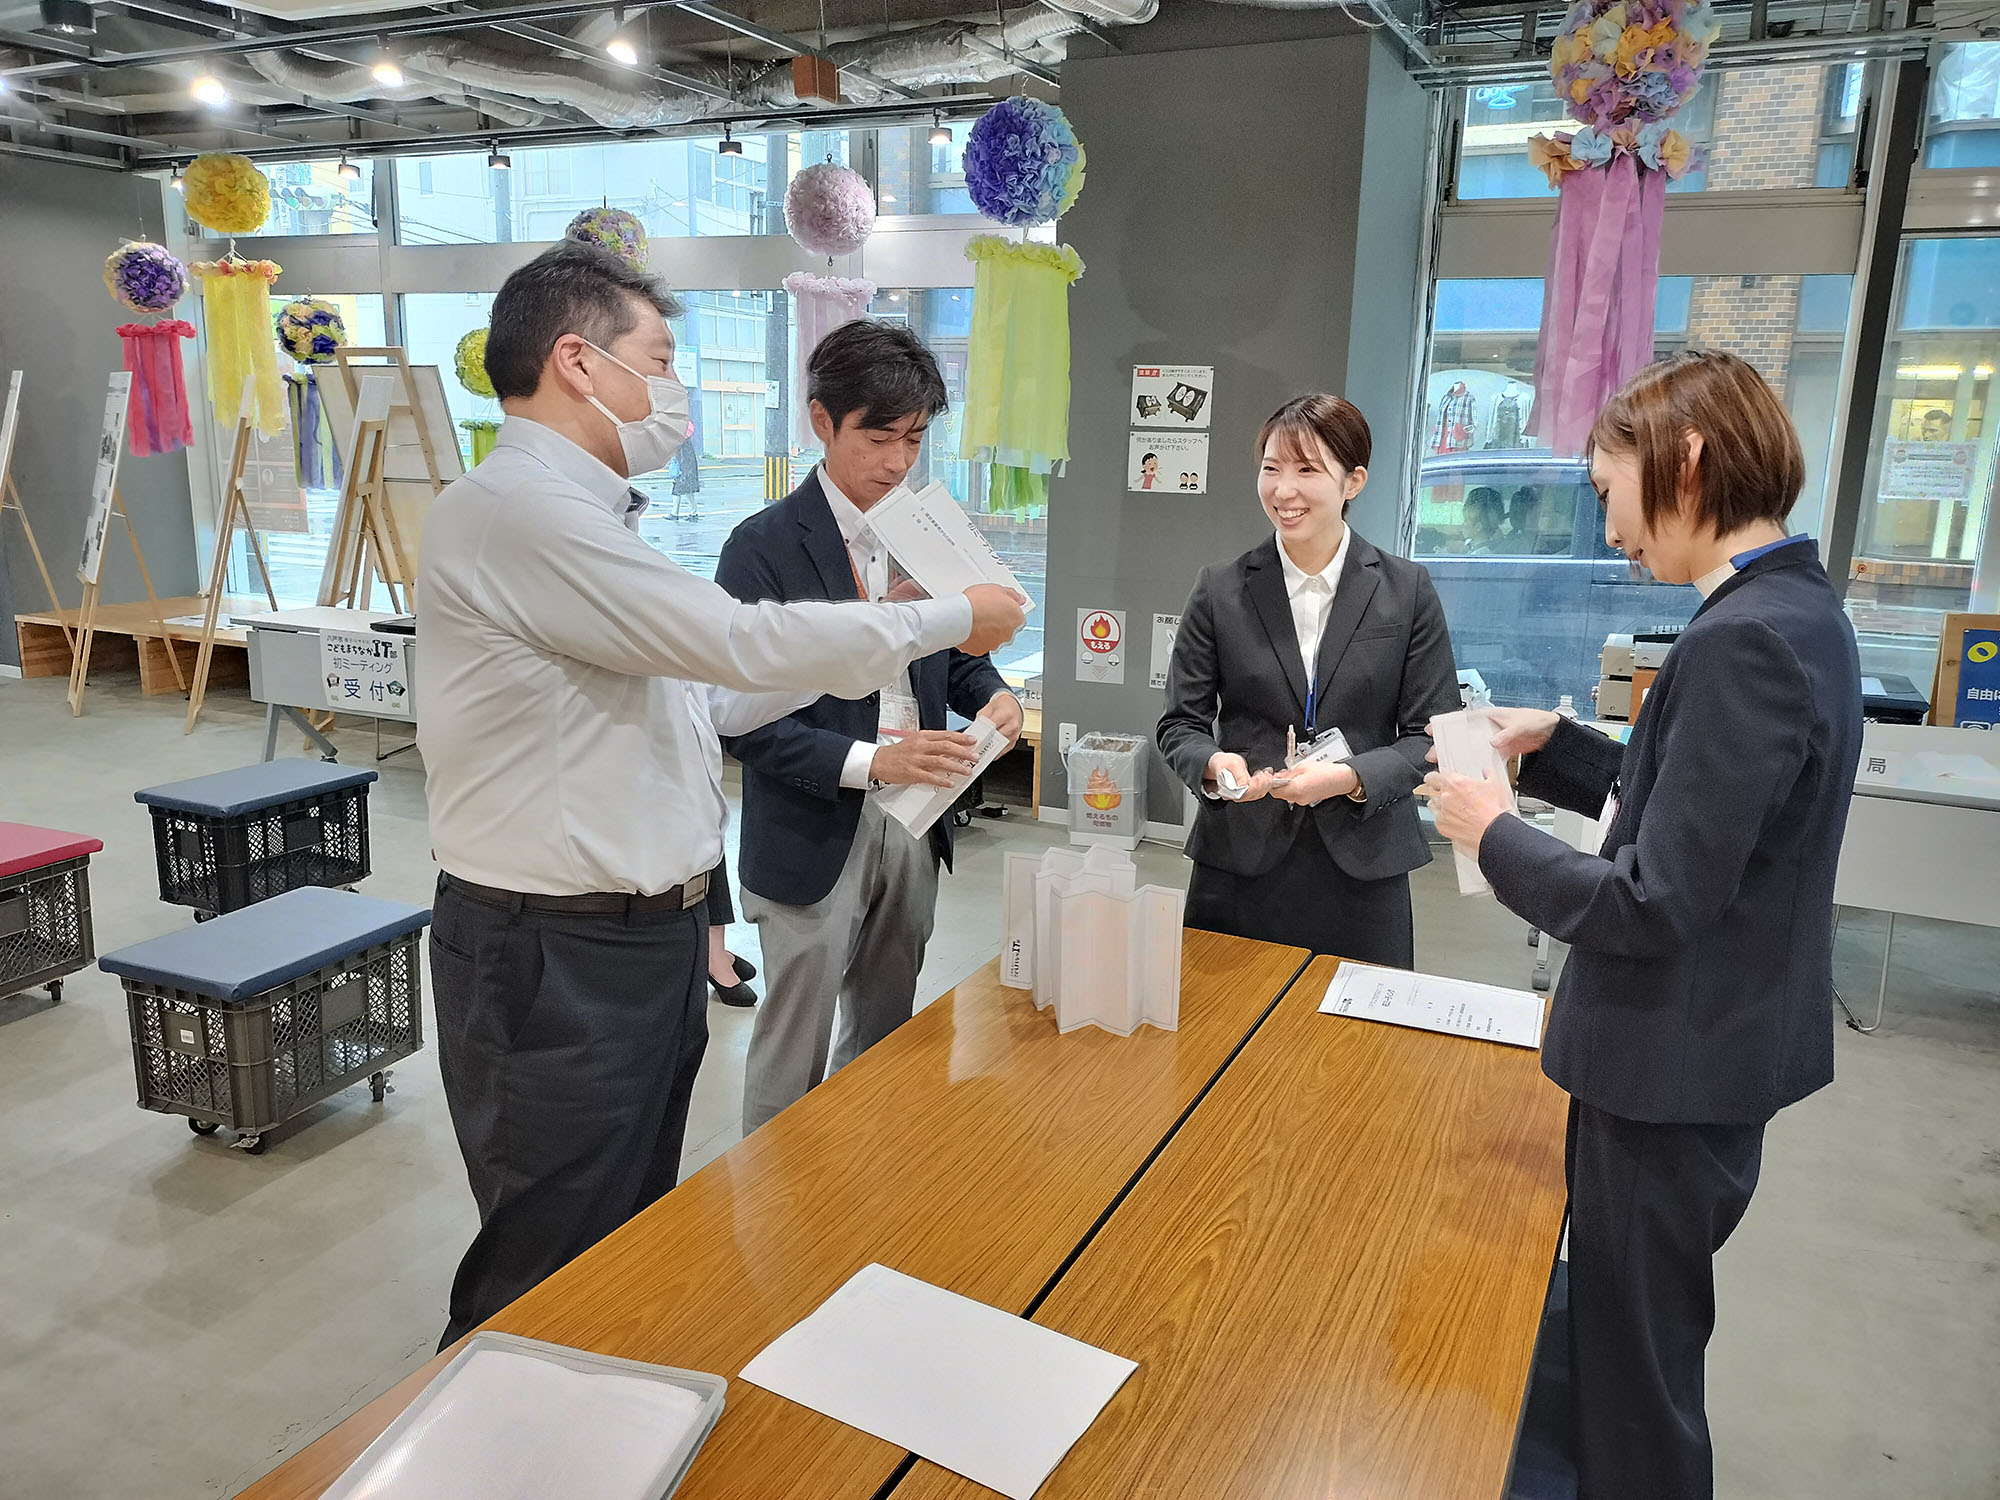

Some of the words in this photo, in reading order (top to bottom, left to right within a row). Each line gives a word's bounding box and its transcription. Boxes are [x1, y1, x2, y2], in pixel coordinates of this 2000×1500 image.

[1090, 641, 1111, 650] もえる
[333, 656, 393, 674] 初ミーティング
[1866, 757, 1887, 775] 局
